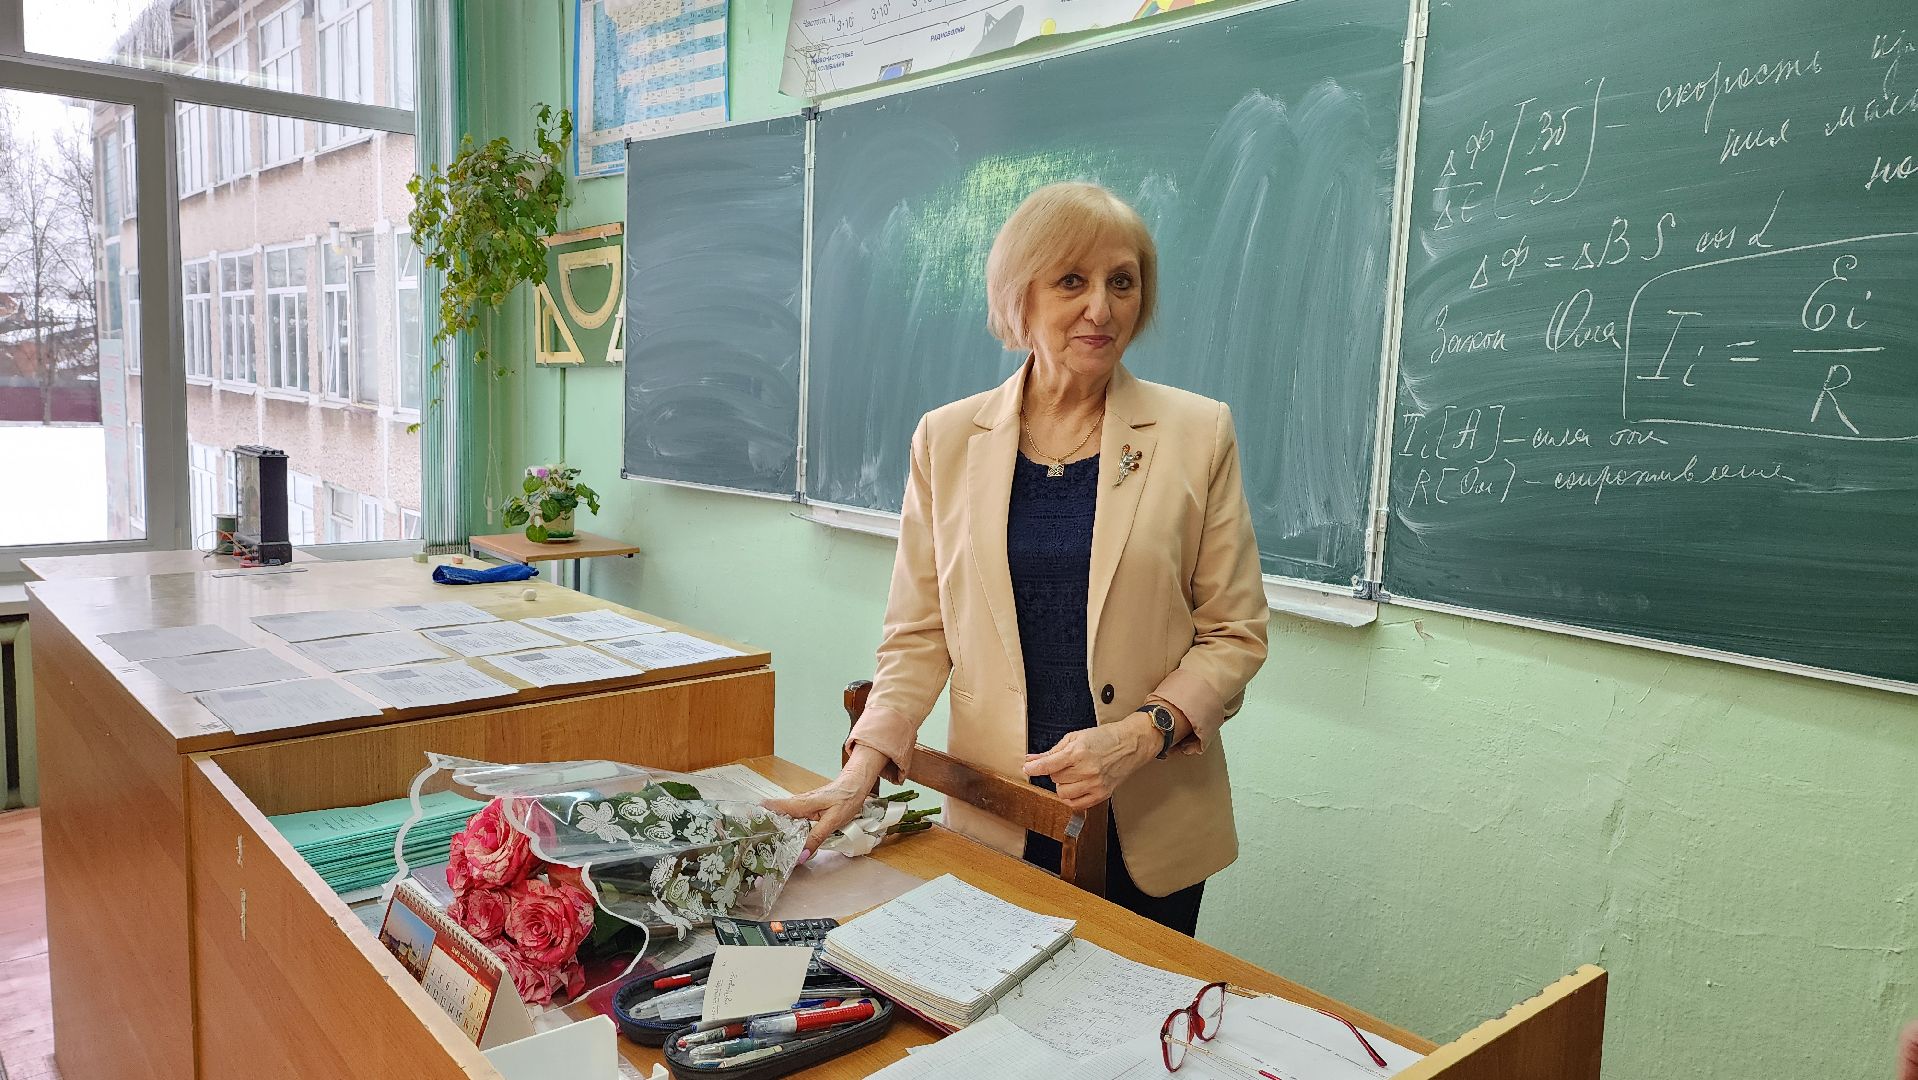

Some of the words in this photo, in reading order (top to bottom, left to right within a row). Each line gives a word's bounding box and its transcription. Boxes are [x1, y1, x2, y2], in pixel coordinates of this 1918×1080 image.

[930, 26, 966, 42] РАДИОВОЛНЫ
[1656, 50, 1824, 134] скорость
[1431, 304, 1509, 364] Закон
[1532, 427, 1593, 449] сила
[1554, 454, 1796, 506] сопротивление
